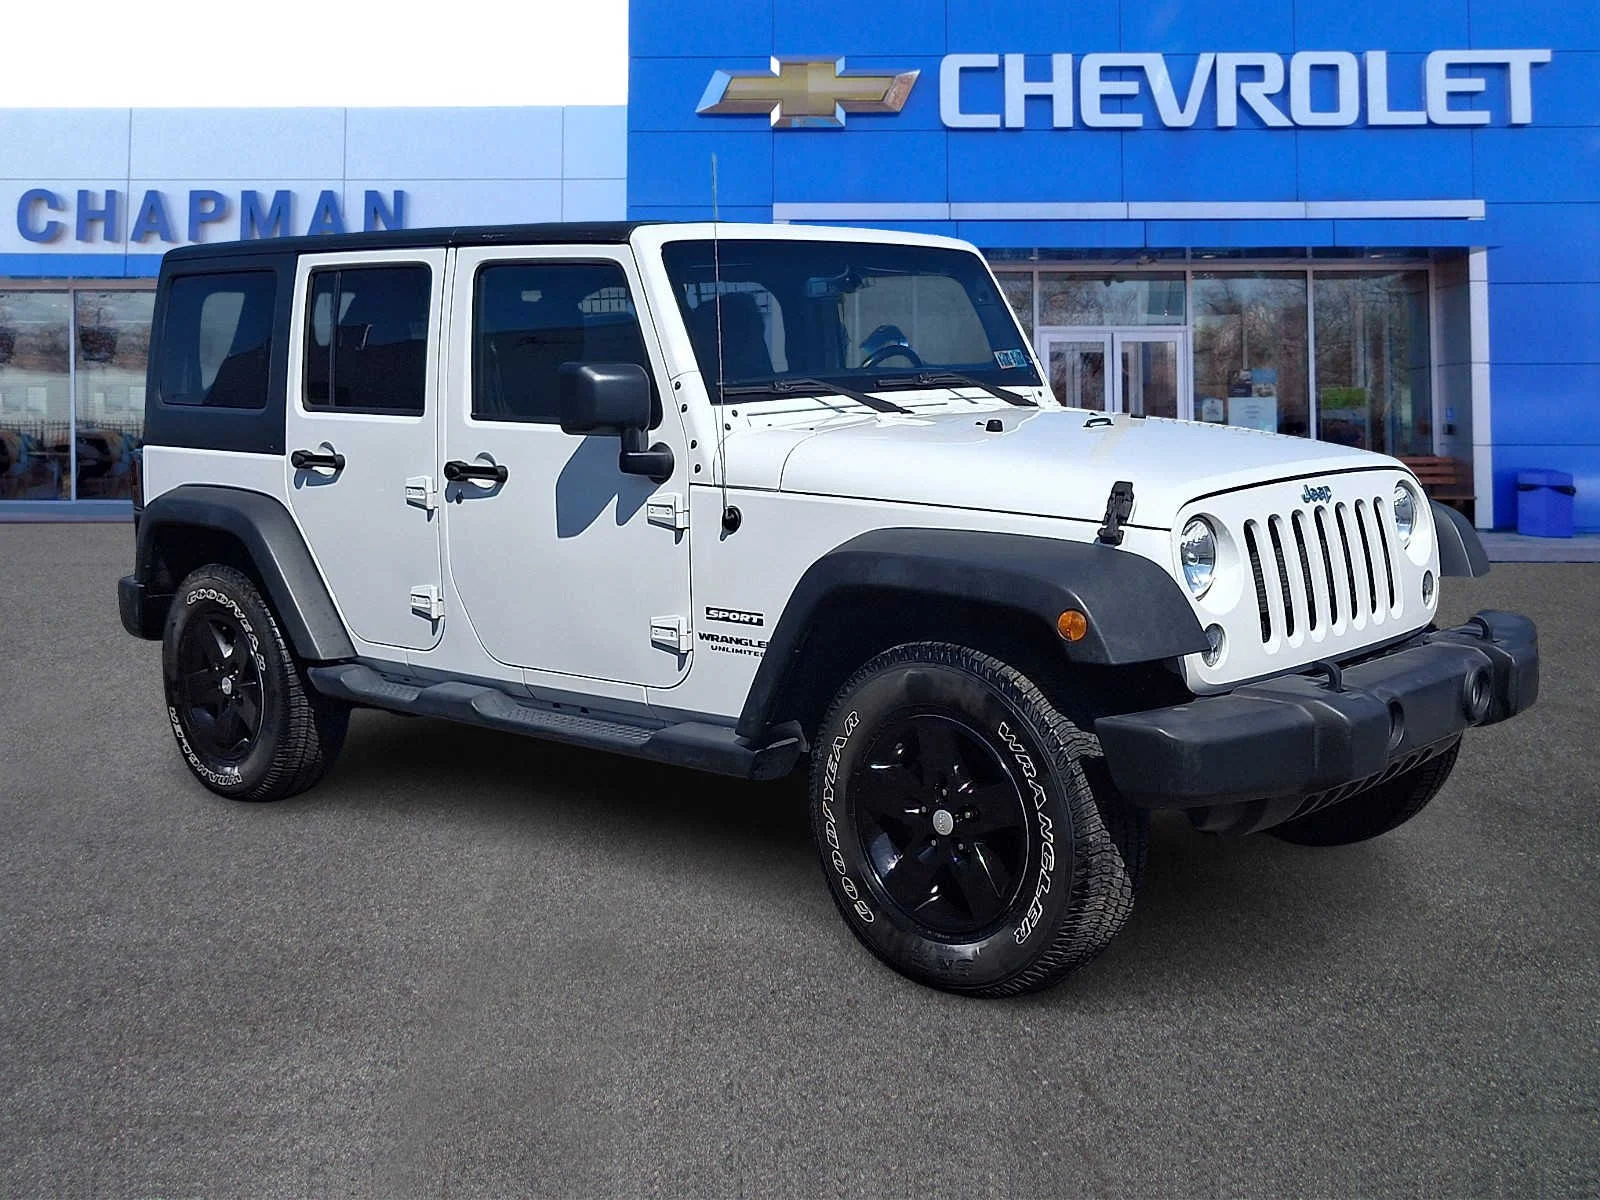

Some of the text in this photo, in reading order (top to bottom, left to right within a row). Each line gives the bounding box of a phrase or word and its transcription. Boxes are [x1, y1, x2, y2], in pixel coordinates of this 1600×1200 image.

[939, 49, 1552, 128] CHEVROLET
[16, 188, 407, 244] CHAPMAN
[1302, 484, 1332, 504] Jeep
[187, 588, 266, 672] GOODYEAR
[706, 608, 763, 625] SPORT
[822, 710, 875, 923] GOODYEAR
[997, 720, 1056, 945] WRANGLER
